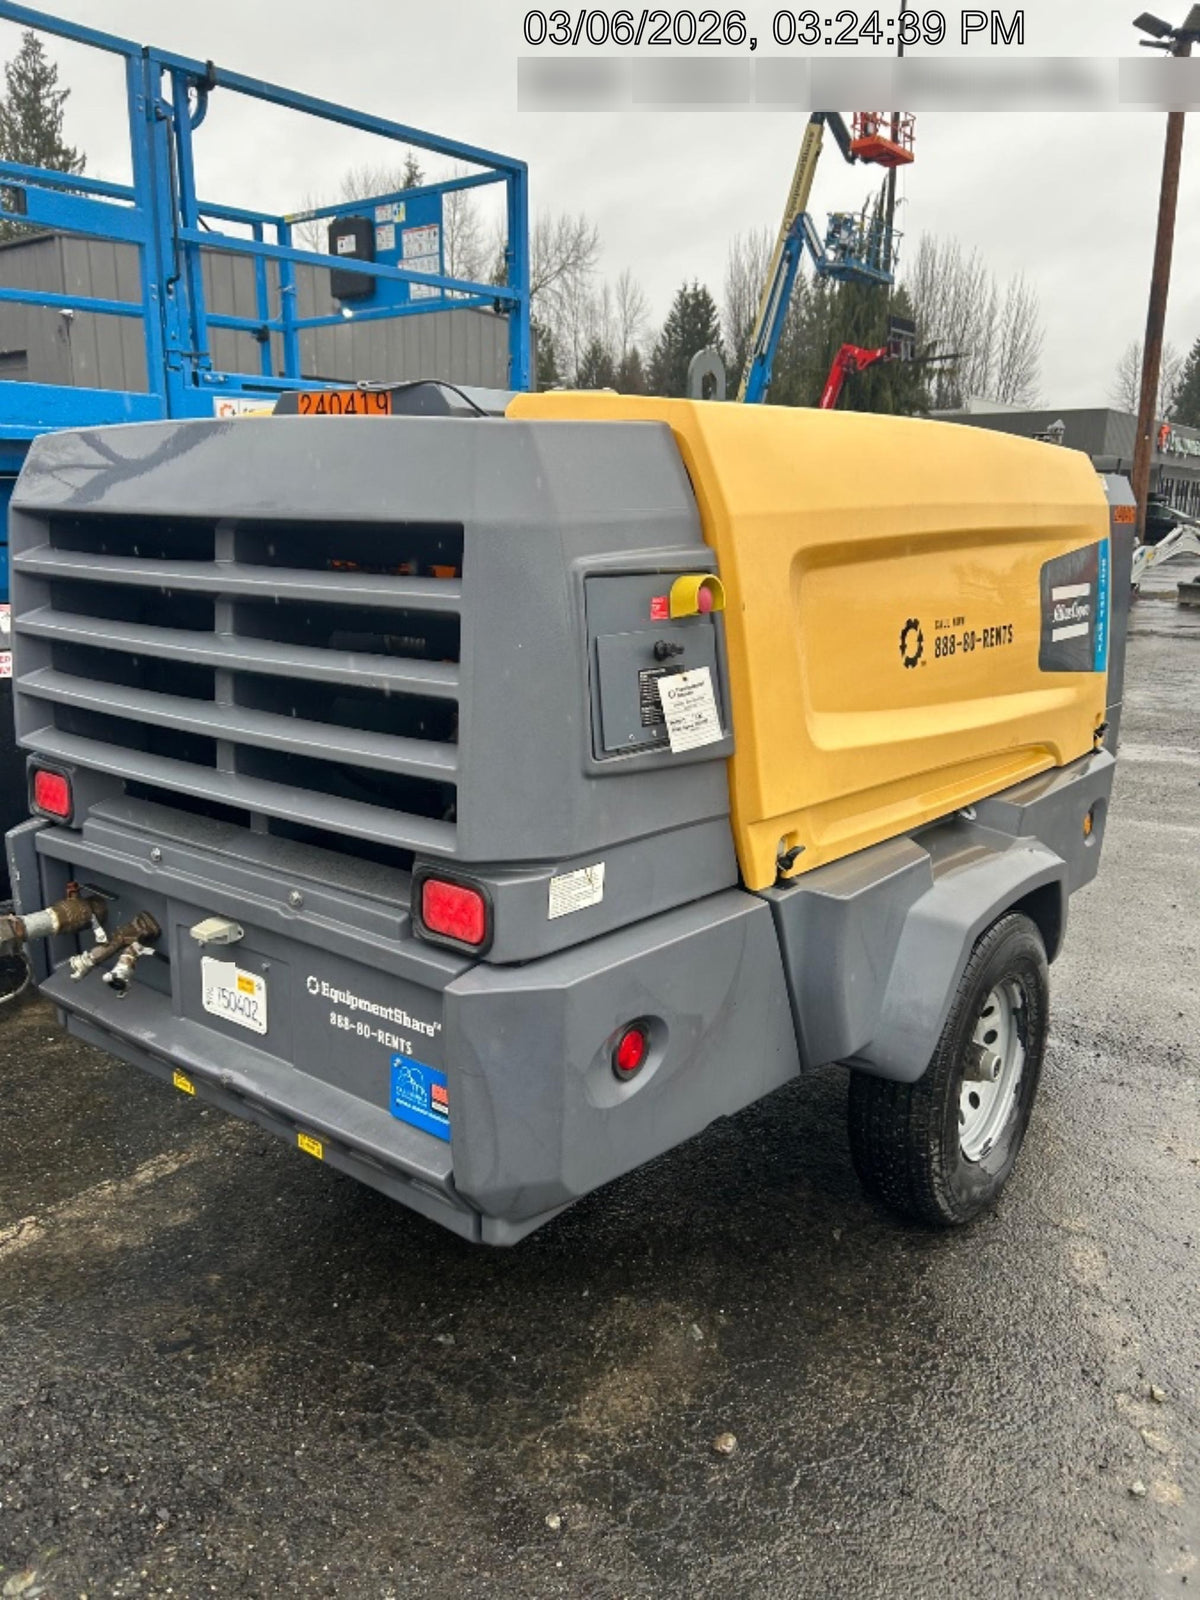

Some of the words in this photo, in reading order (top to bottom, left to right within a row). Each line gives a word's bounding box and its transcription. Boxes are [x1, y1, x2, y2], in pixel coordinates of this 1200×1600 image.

[300, 391, 389, 415] 240419
[934, 623, 1013, 659] 888-80-RENTS
[329, 1011, 413, 1055] 888-80-RENTS
